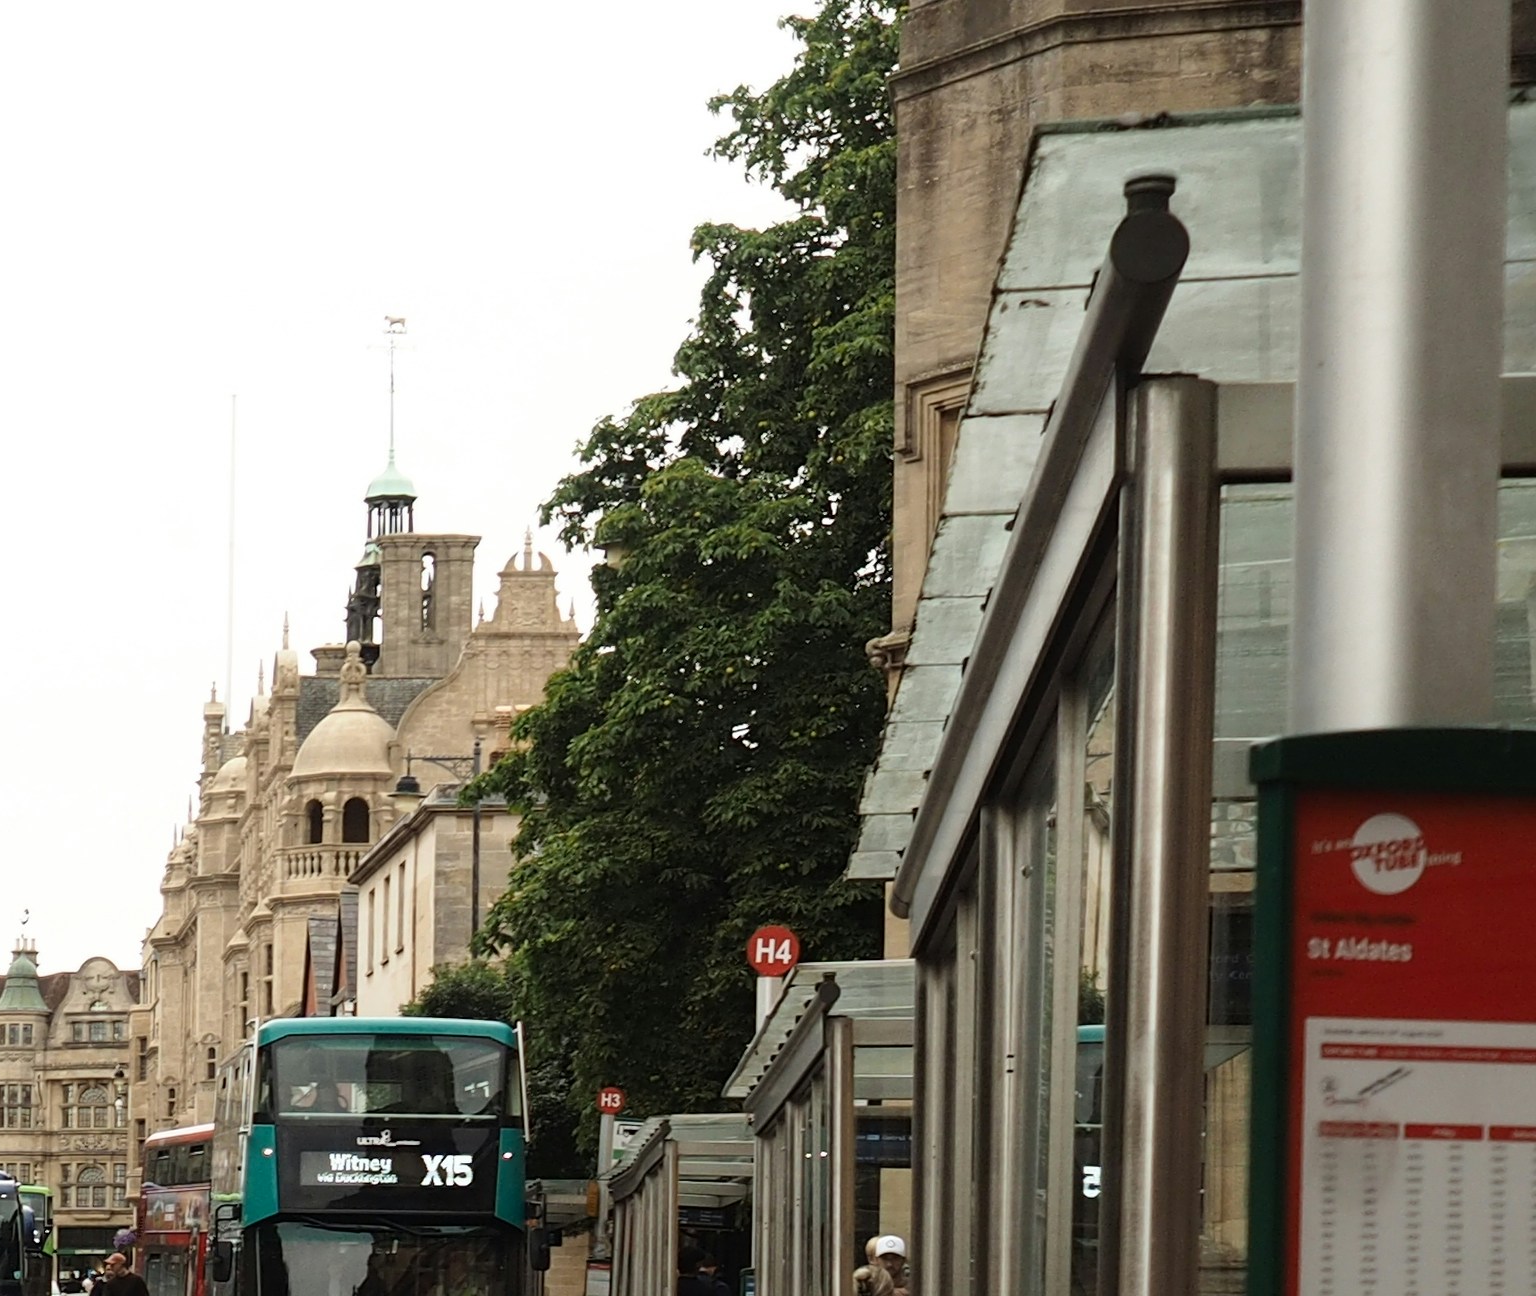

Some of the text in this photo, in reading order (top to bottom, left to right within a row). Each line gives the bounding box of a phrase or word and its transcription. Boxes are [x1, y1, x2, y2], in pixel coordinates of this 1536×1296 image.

[755, 937, 792, 965] H4
[1307, 937, 1413, 963] St Aldates
[601, 1093, 621, 1108] H3
[329, 1153, 474, 1187] Witney X15
